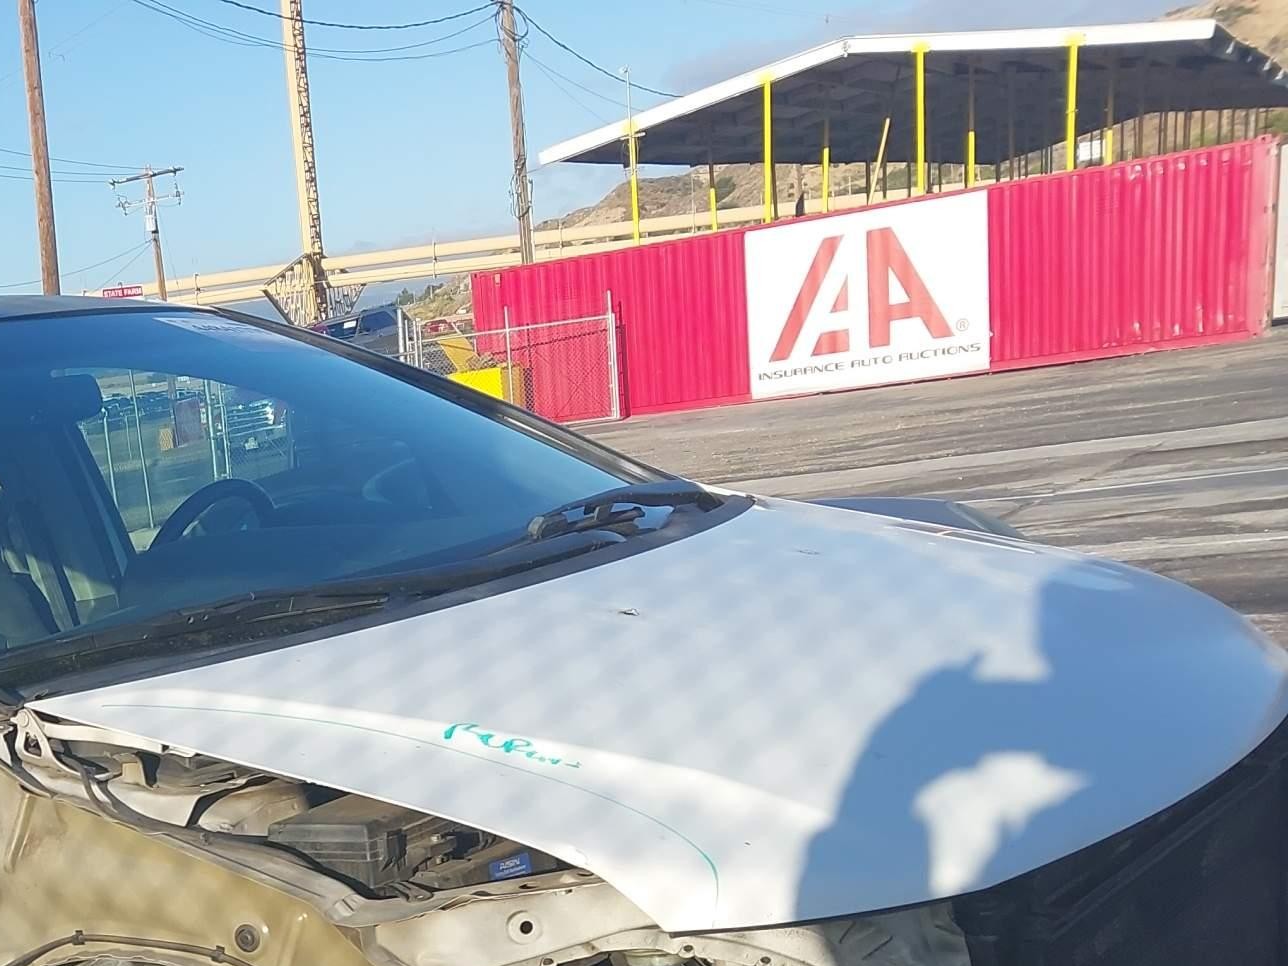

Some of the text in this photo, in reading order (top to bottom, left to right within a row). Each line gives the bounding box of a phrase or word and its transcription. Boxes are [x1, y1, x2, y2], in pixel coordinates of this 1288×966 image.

[758, 342, 981, 381] INSURANCE AUTO AUCTIONS
